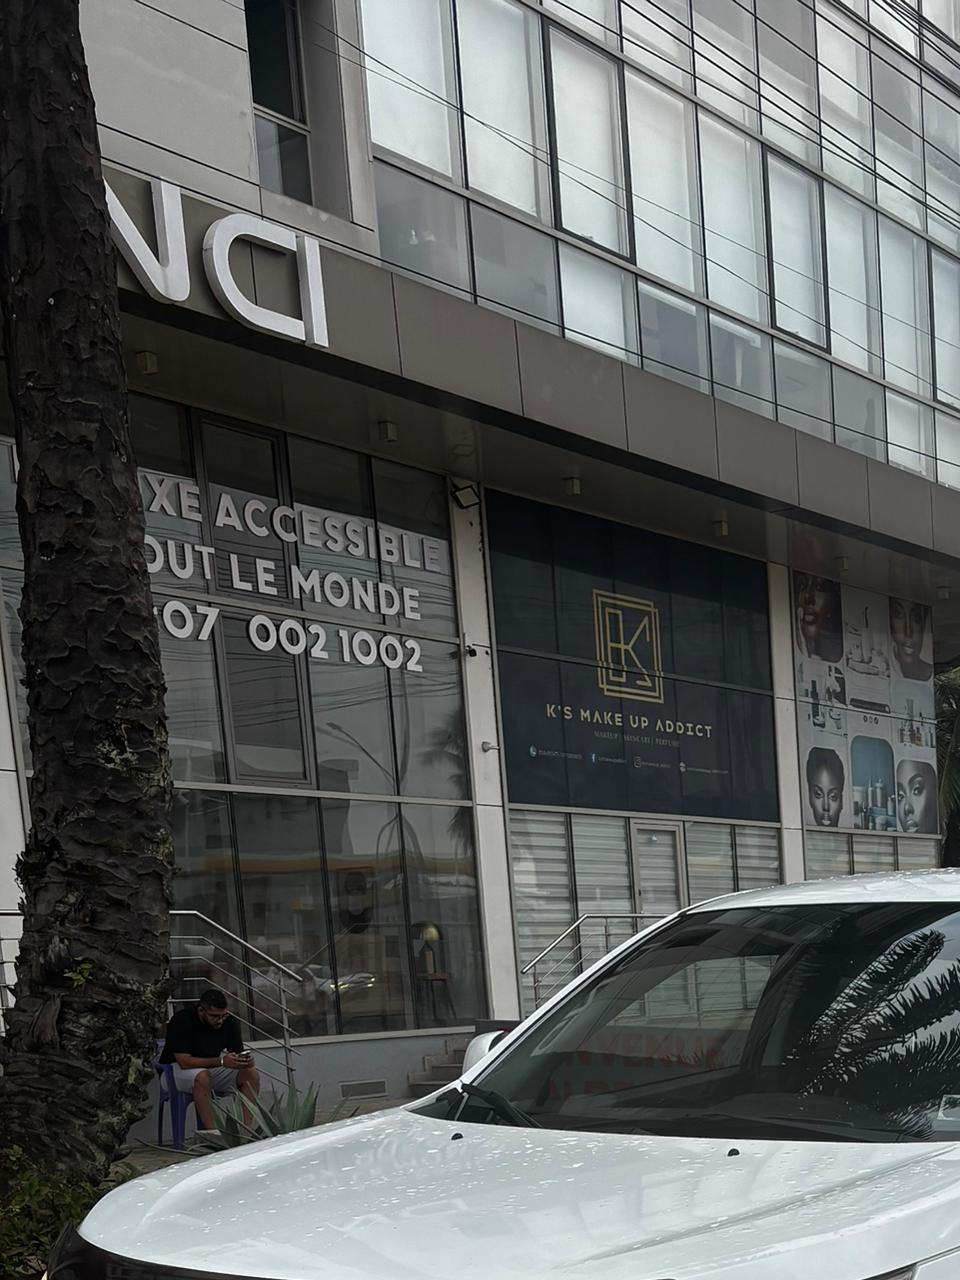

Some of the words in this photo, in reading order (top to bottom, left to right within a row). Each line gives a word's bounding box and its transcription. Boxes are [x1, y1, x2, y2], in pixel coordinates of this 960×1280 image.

[215, 493, 442, 572] ACCESSIBLE
[230, 554, 278, 596] LE
[291, 564, 421, 620] MONDE
[153, 600, 220, 640] 07
[249, 614, 329, 660] 002
[339, 629, 423, 673] 1002
[546, 703, 573, 720] K'S
[580, 709, 623, 726] MAKE
[629, 715, 649, 729] UP
[655, 719, 713, 738] ADDICT
